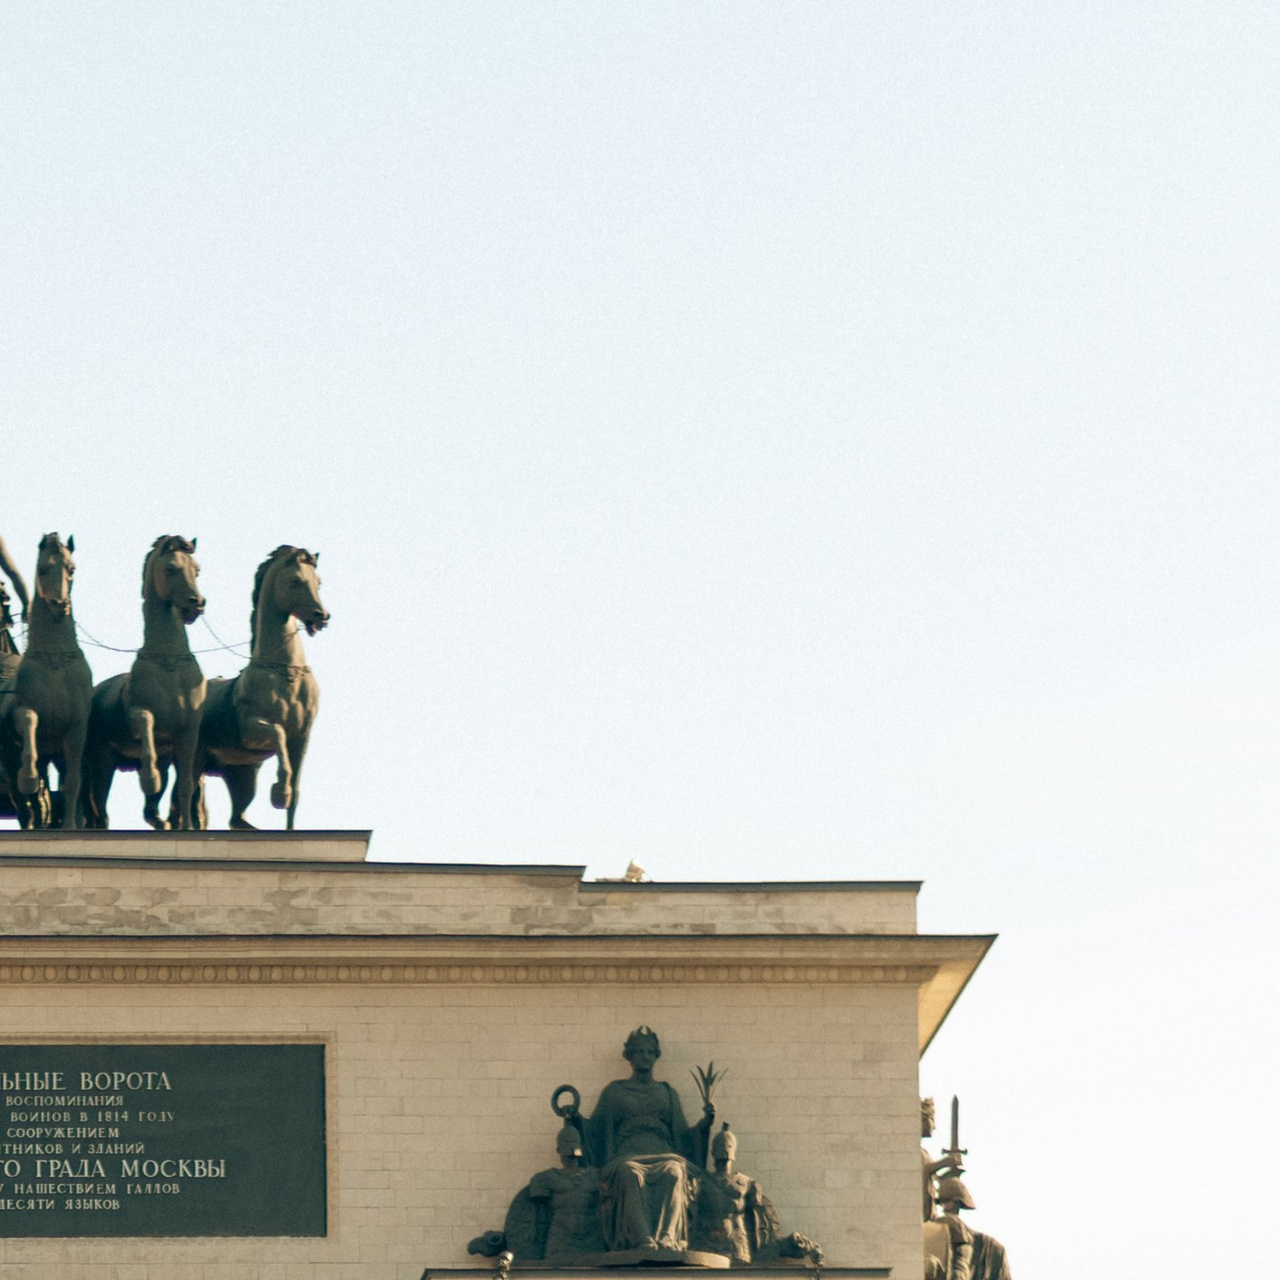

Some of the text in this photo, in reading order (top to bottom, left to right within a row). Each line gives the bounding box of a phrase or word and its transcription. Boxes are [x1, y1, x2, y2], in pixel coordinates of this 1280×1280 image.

[79, 1071, 172, 1091] ВОРОТА
[5, 1095, 124, 1107] ВОСПОМИНАНИЯ
[10, 1111, 71, 1123] ВОИНОВ
[79, 1111, 88, 1123] В
[97, 1110, 129, 1123] 1814
[138, 1111, 175, 1123] ГОДУ
[6, 1126, 120, 1139] СООРУЖЕНИЕМ
[71, 1143, 81, 1155] И
[87, 1141, 145, 1155] ЗДАНИЙ
[35, 1158, 107, 1178] ГРАДА
[120, 1158, 226, 1178] МОСКВЫ
[13, 1183, 116, 1195] НАШЕСТВИЕМ
[126, 1183, 181, 1195] ГАЛЛОВ
[64, 1198, 121, 1211] ЯЗЫКОВ
